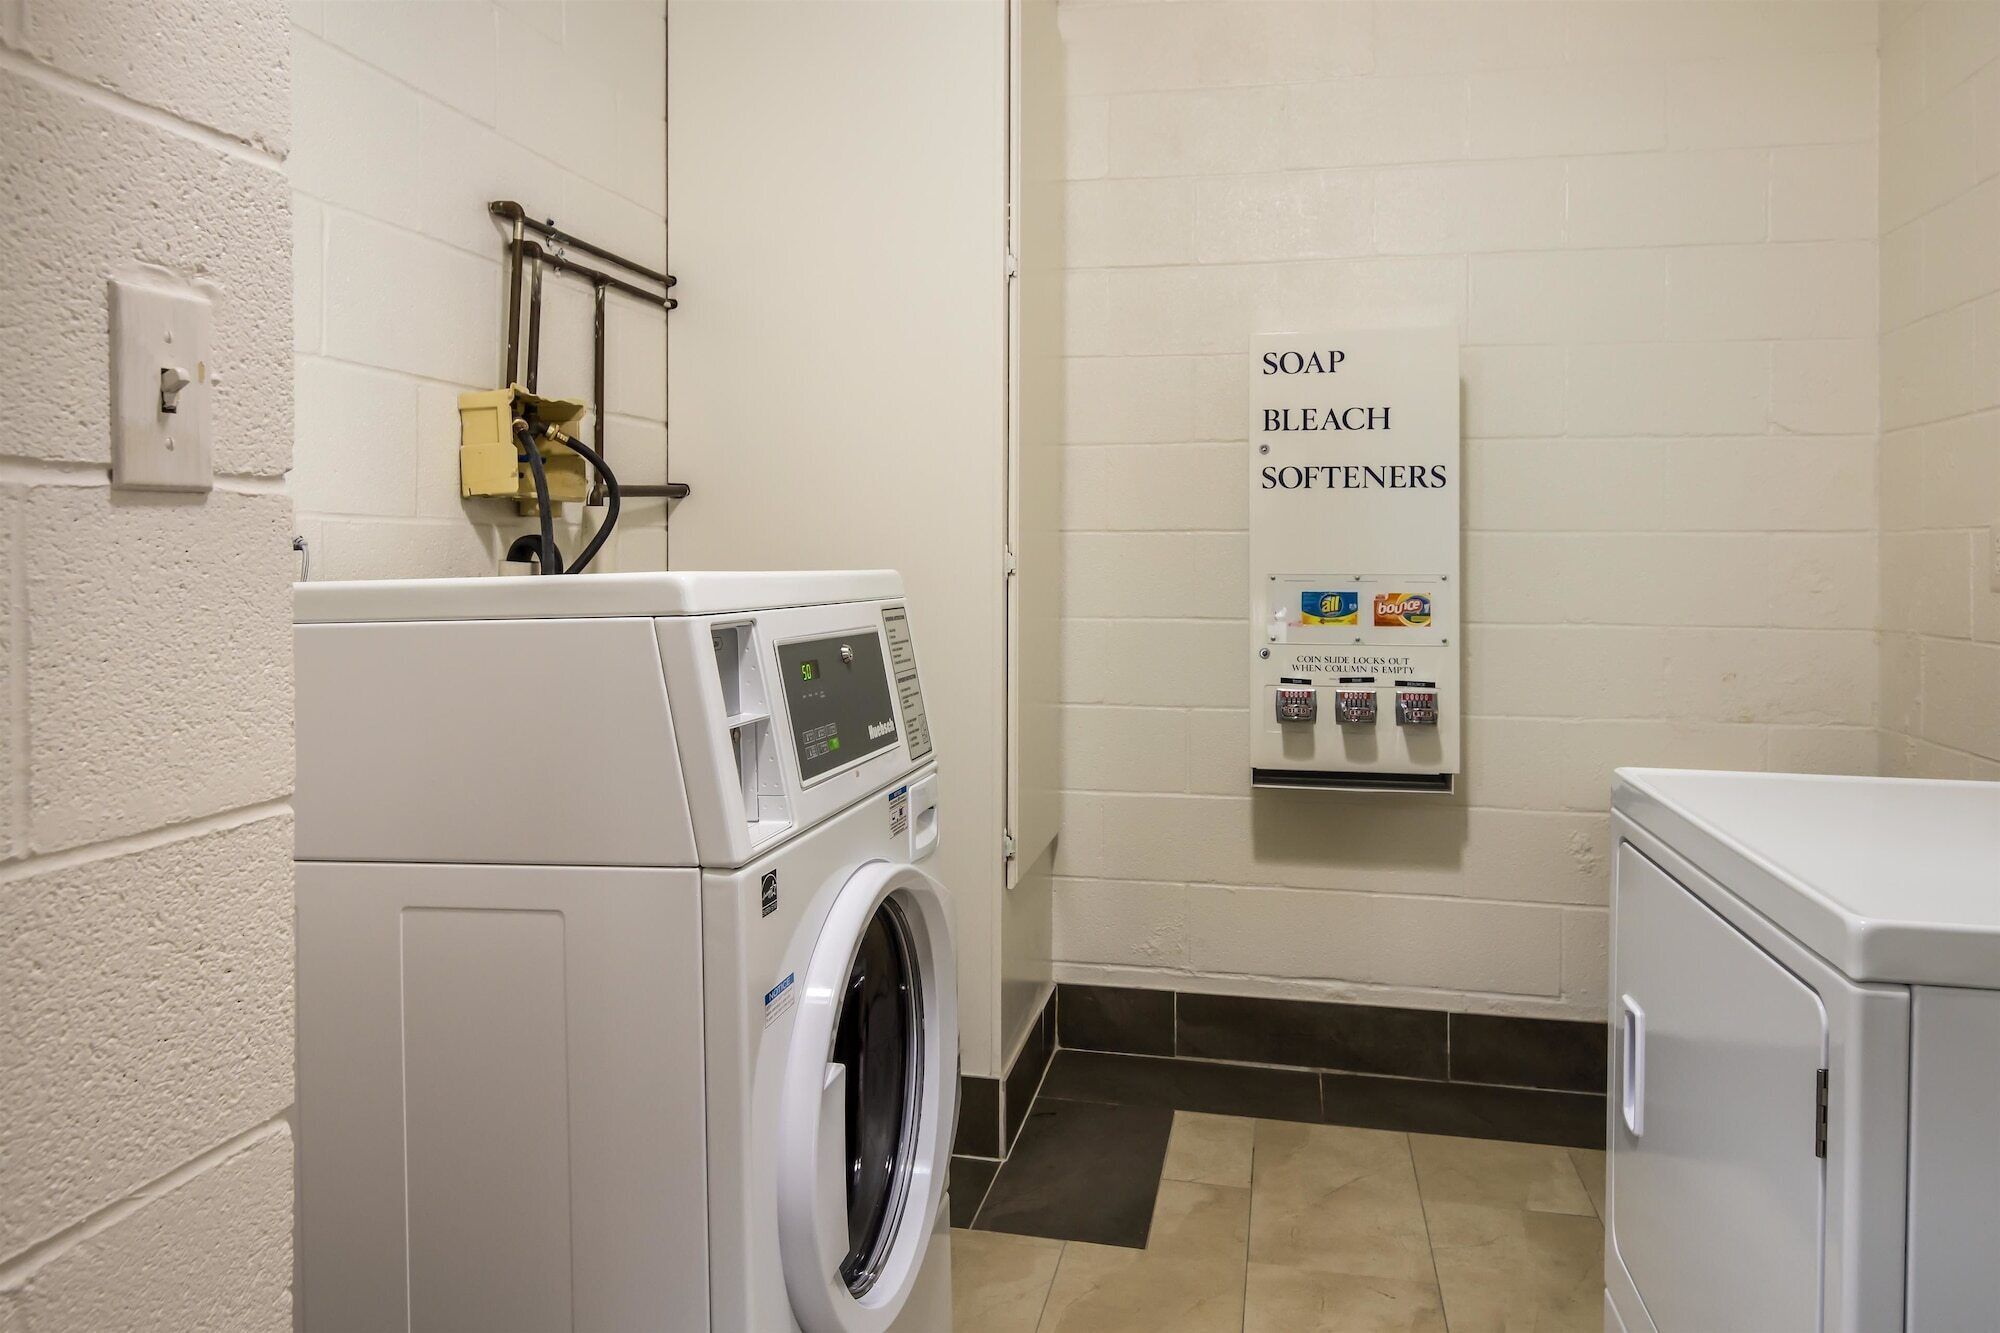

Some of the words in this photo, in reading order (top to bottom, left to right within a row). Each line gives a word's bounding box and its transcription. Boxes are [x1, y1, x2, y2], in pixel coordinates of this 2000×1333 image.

[1263, 350, 1345, 375] SOAP
[1263, 407, 1391, 431] BLEACH
[1262, 465, 1446, 489] SOFTENERS
[1320, 595, 1340, 613] all
[1377, 599, 1422, 616] bounce
[1292, 664, 1321, 672] WHEN
[1324, 664, 1366, 673] COLUMN
[1370, 665, 1378, 673] IS
[1382, 666, 1415, 674] EMPTY
[1296, 655, 1321, 664] COIN
[1324, 656, 1350, 664] SLIDE
[1353, 656, 1385, 665] LOCKS
[1388, 657, 1410, 665] OUT
[767, 976, 792, 1002] NOTICE
